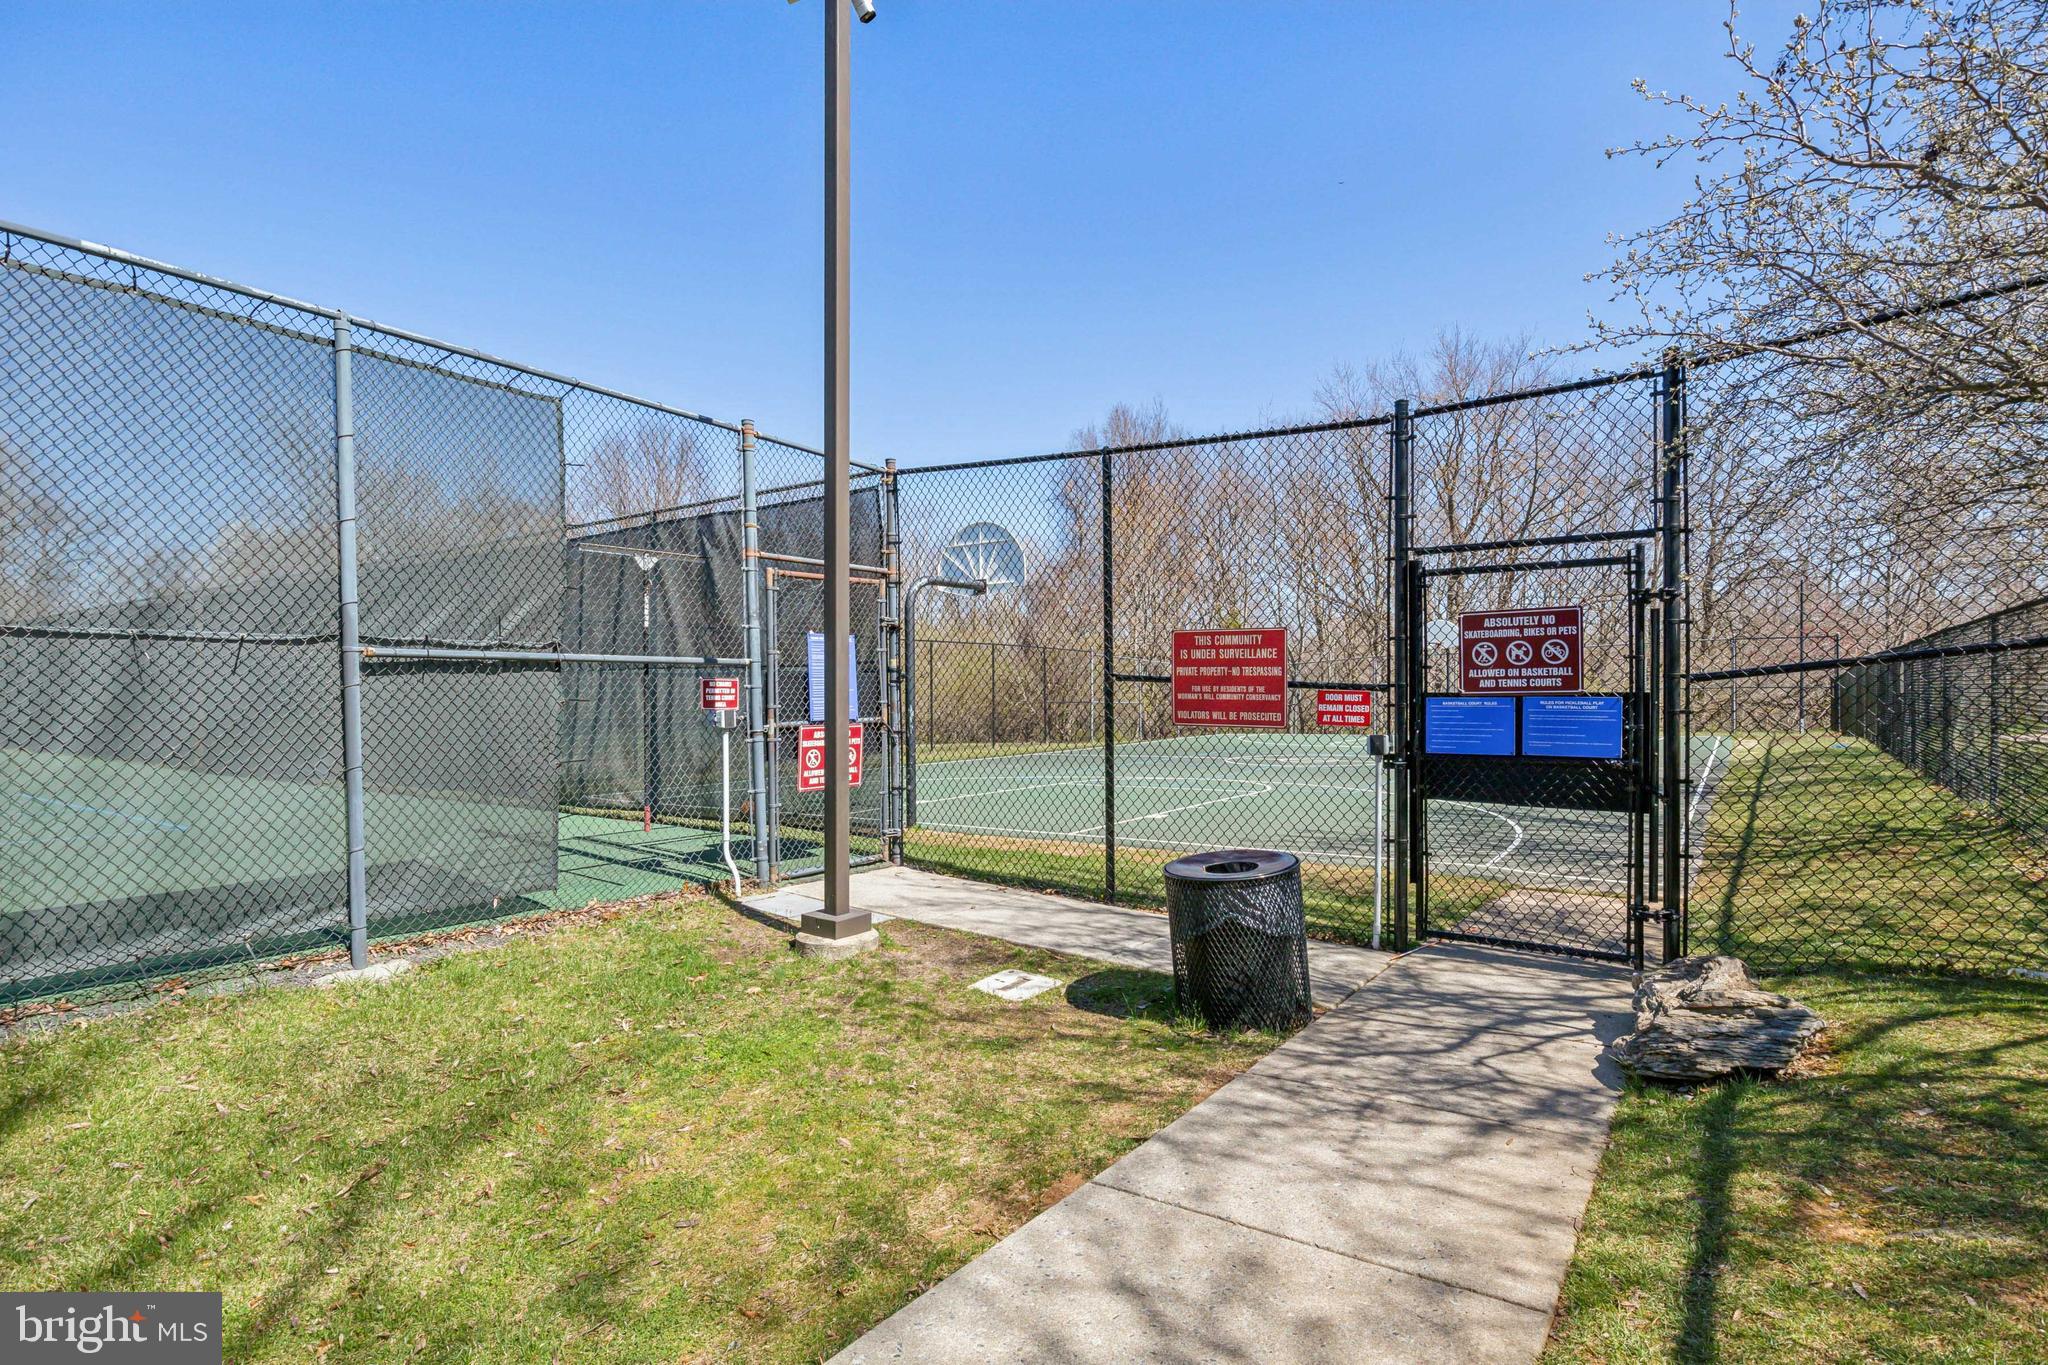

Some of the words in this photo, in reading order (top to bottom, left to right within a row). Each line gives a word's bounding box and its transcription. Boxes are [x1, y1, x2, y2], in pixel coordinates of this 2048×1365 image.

[1484, 616, 1539, 627] ABSOLUTELY
[1542, 615, 1555, 624] NO
[1464, 629, 1522, 639] SKATEBOARDING,
[1524, 628, 1544, 636] BIKES
[1559, 626, 1577, 635] PETS
[1195, 636, 1211, 645] THIS
[1215, 635, 1262, 645] COMMUNITY
[1180, 650, 1187, 659] IS
[1191, 649, 1216, 659] UNDER
[1220, 648, 1277, 658] SURVEILLANCE
[1177, 667, 1198, 676] PRIVATE
[1242, 667, 1282, 676] TRESPASSING
[1469, 669, 1505, 677] ALLOWED
[1522, 667, 1573, 676] BASKETBALL
[1530, 678, 1562, 686] COURTS
[1178, 711, 1209, 719] VIOLATORS
[1212, 711, 1227, 720] WILL
[1229, 712, 1237, 720] BE
[1240, 712, 1281, 721] PROSECUTED
